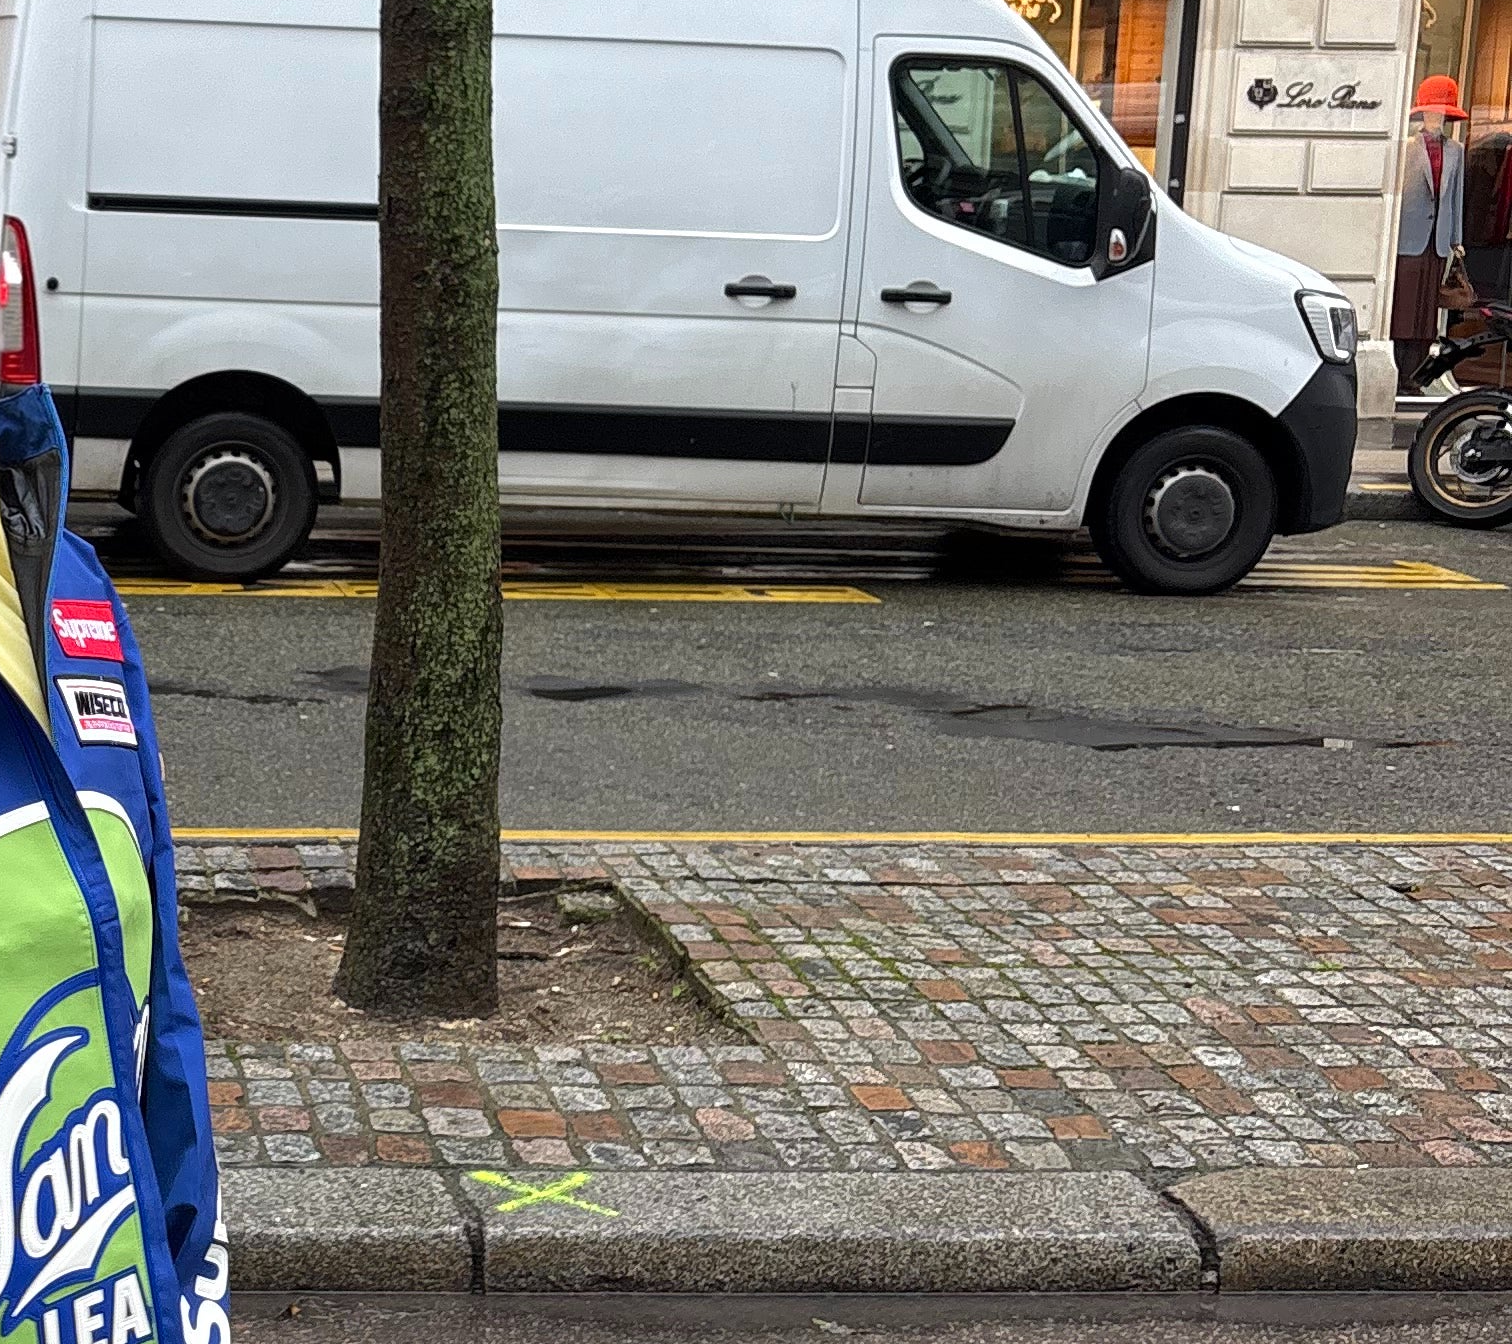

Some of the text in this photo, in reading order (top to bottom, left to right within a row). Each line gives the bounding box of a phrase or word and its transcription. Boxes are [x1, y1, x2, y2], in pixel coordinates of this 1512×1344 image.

[1276, 80, 1382, 109] Loro Piana
[74, 690, 127, 719] WISECO
